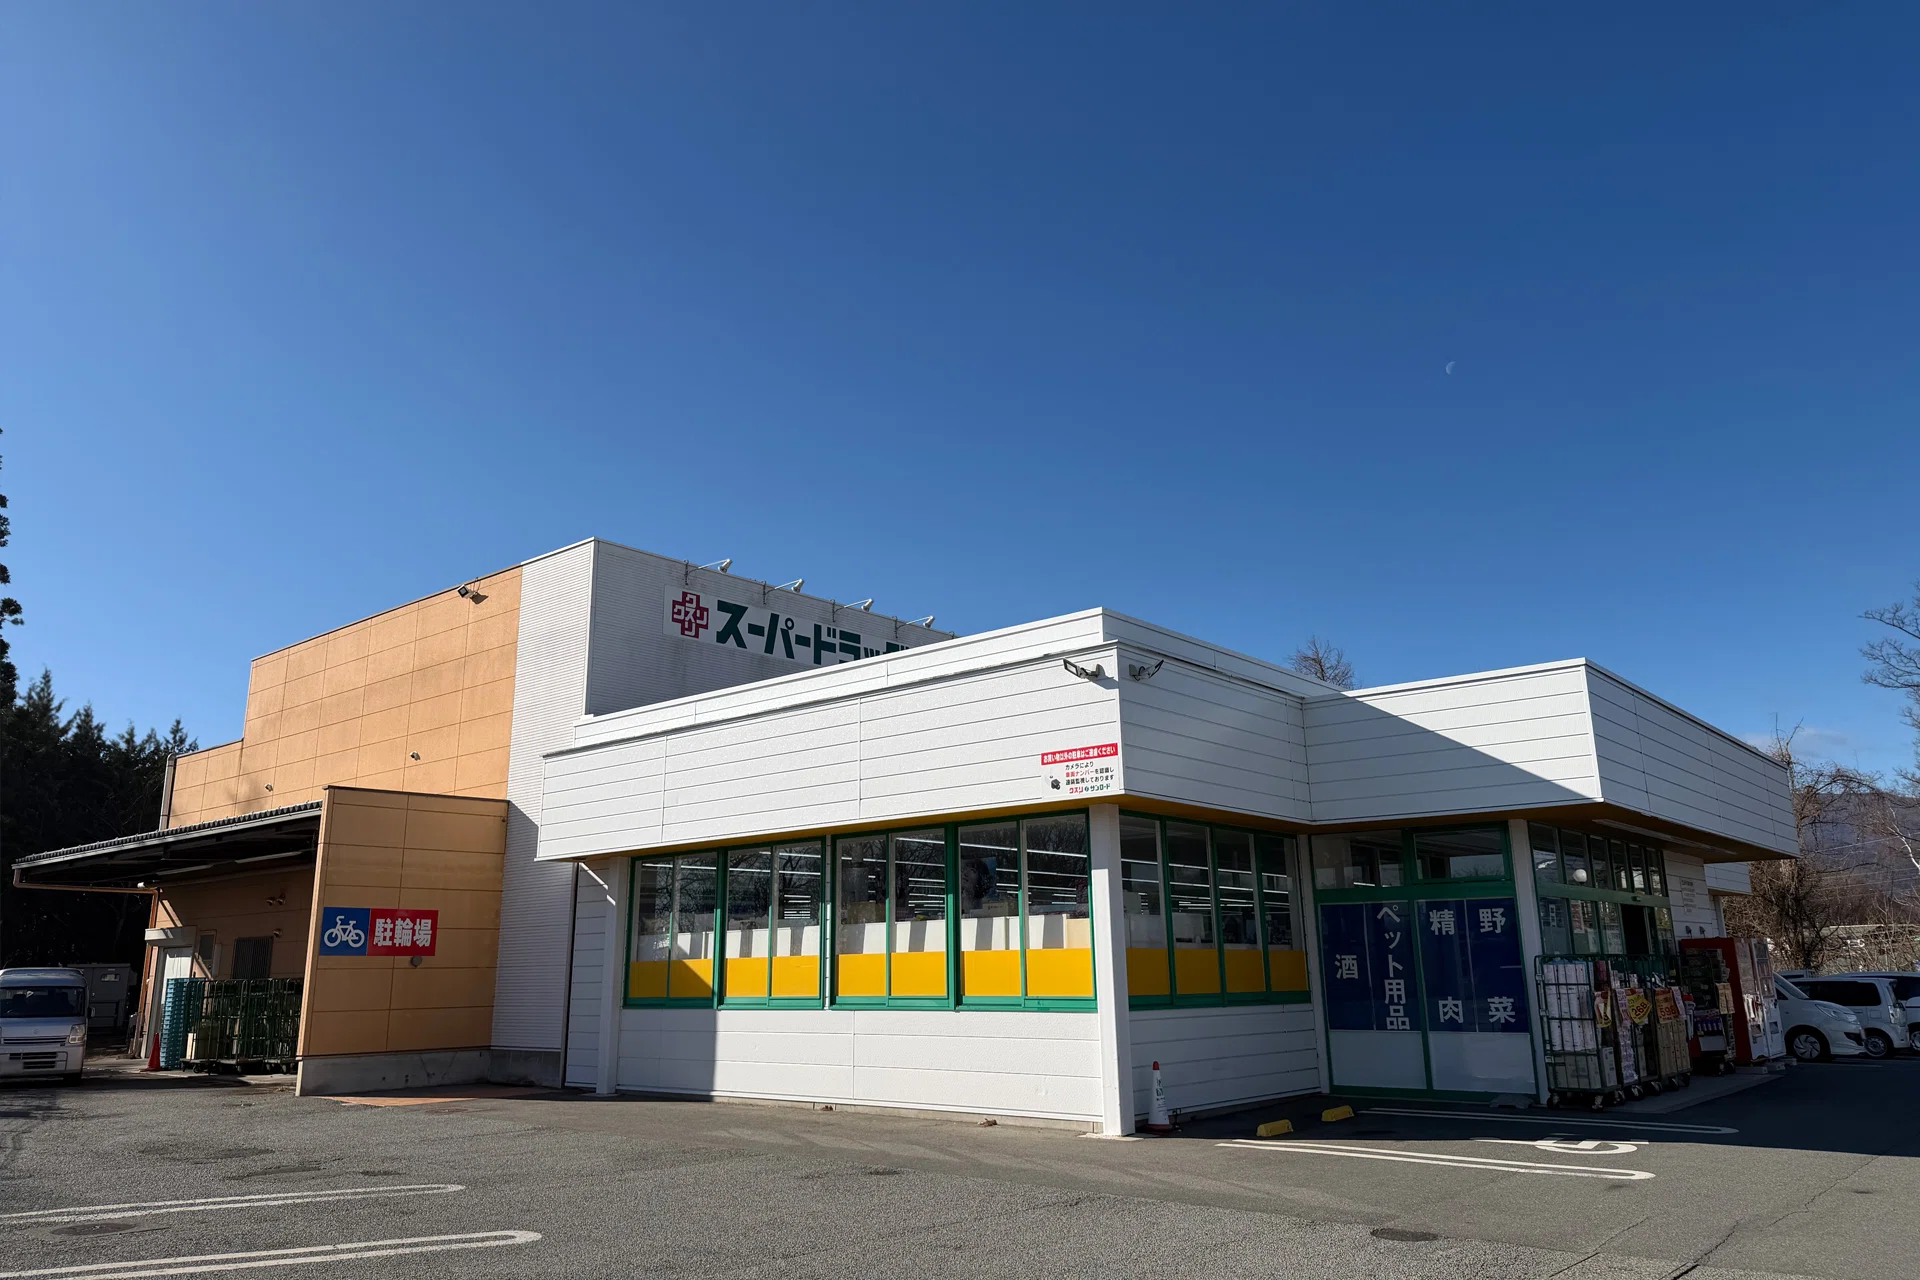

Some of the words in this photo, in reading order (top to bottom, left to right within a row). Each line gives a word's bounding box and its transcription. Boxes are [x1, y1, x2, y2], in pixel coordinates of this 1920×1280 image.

[1065, 761, 1094, 770] カメラにより
[373, 918, 432, 947] 駐輪場
[1334, 953, 1359, 980] 酒
[1376, 904, 1411, 1031] ペット用品
[1429, 909, 1464, 1024] 精肉
[1478, 907, 1516, 1024] 野菜
[1631, 1001, 1648, 1017] 268
